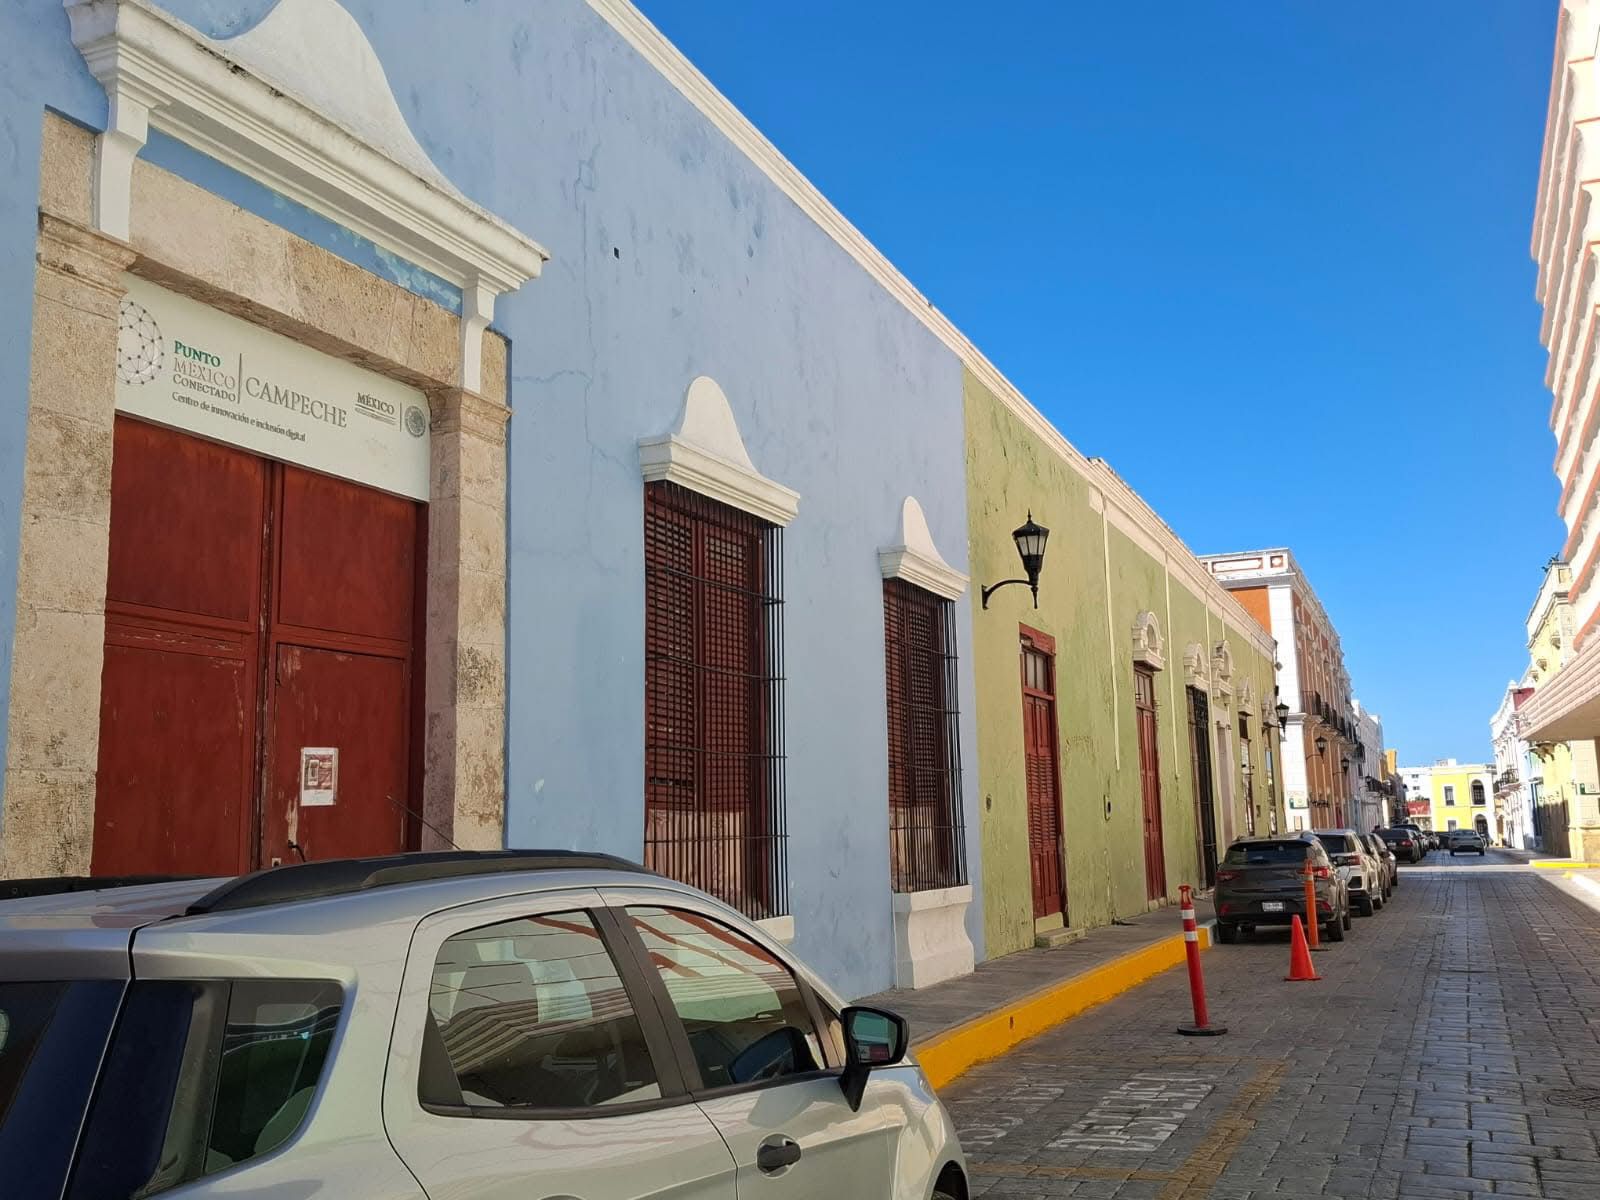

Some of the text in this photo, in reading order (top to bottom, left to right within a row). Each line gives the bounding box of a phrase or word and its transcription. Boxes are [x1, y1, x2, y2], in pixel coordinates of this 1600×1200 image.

[174, 340, 221, 368] PUNTO
[172, 374, 237, 402] CONECTADO
[245, 376, 348, 428] CAMPECHE
[172, 391, 306, 442] Centro de innovación e inclusión digital
[357, 392, 395, 415] MÉXICO
